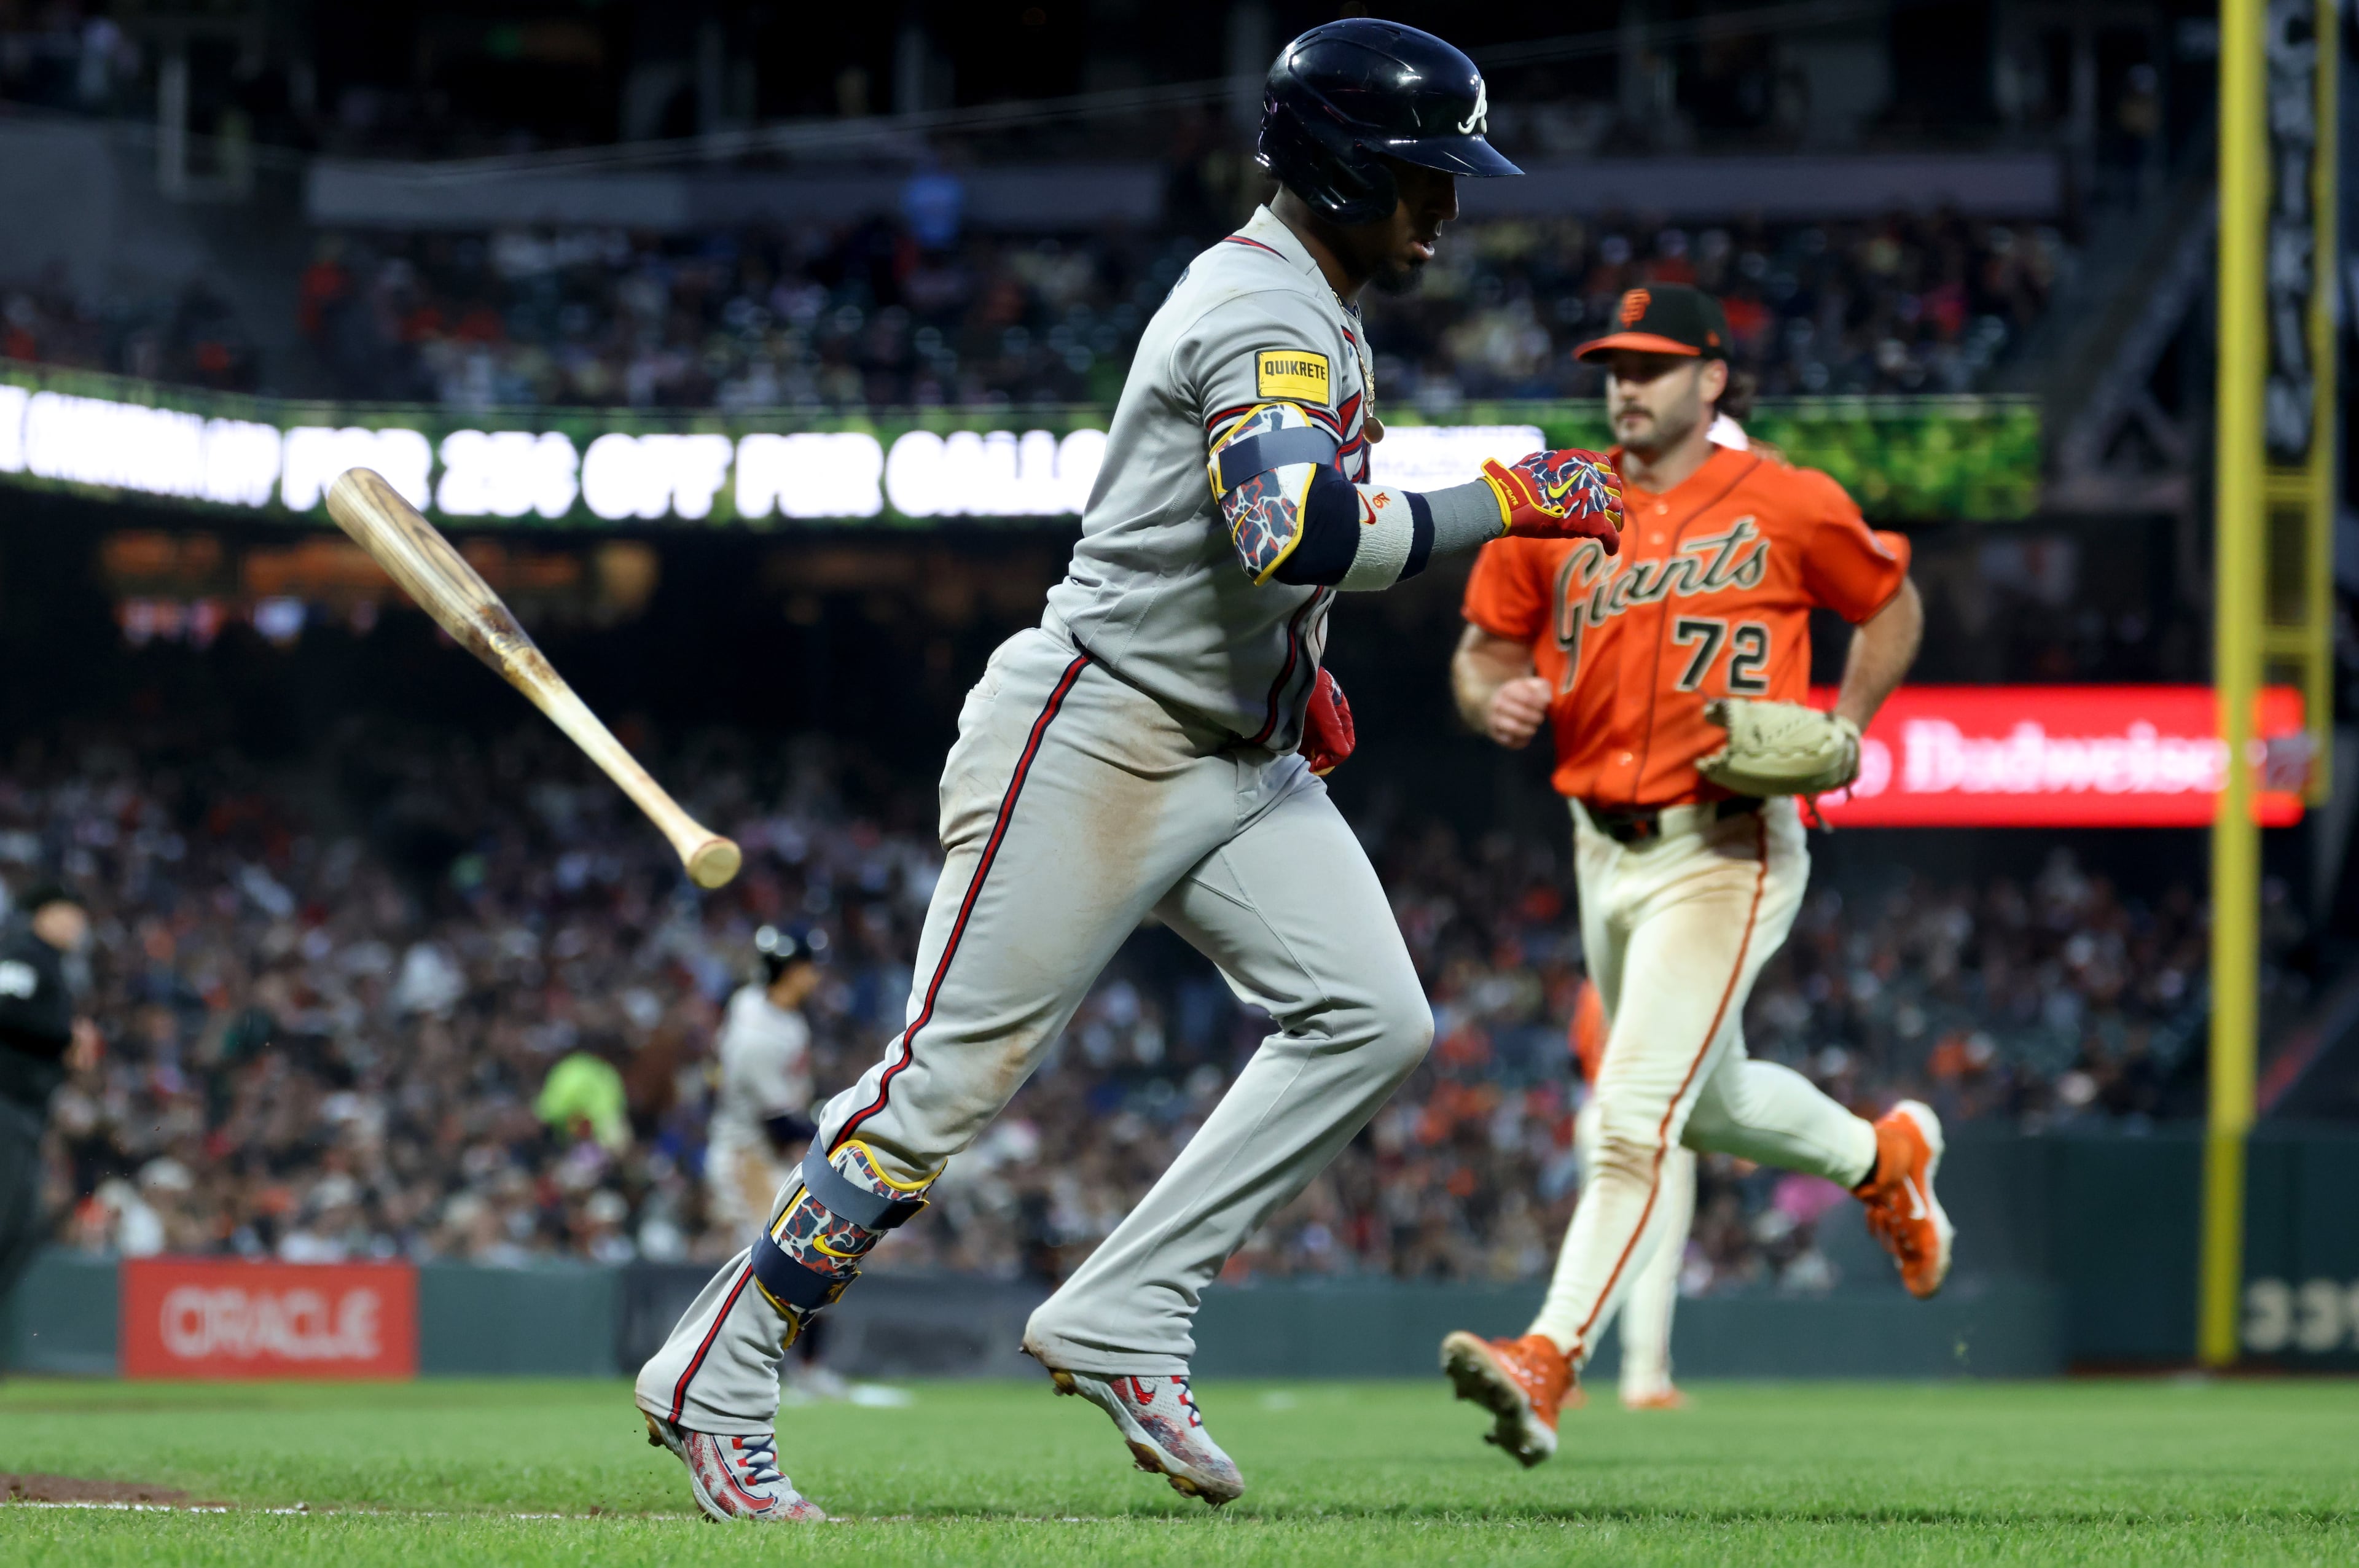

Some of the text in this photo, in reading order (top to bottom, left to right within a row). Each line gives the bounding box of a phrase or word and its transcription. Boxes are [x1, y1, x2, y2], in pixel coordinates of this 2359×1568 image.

[1457, 79, 1488, 135] A
[1265, 360, 1326, 380] QUIKRETE
[581, 432, 734, 520] OFF
[735, 431, 885, 518] PER
[885, 428, 1111, 518] GALLO
[1505, 489, 1519, 507] ELITE
[1554, 515, 1772, 695] Giants
[1673, 616, 1772, 696] 72
[1903, 717, 2233, 795] Budweiser
[160, 1285, 381, 1360] ORACLE
